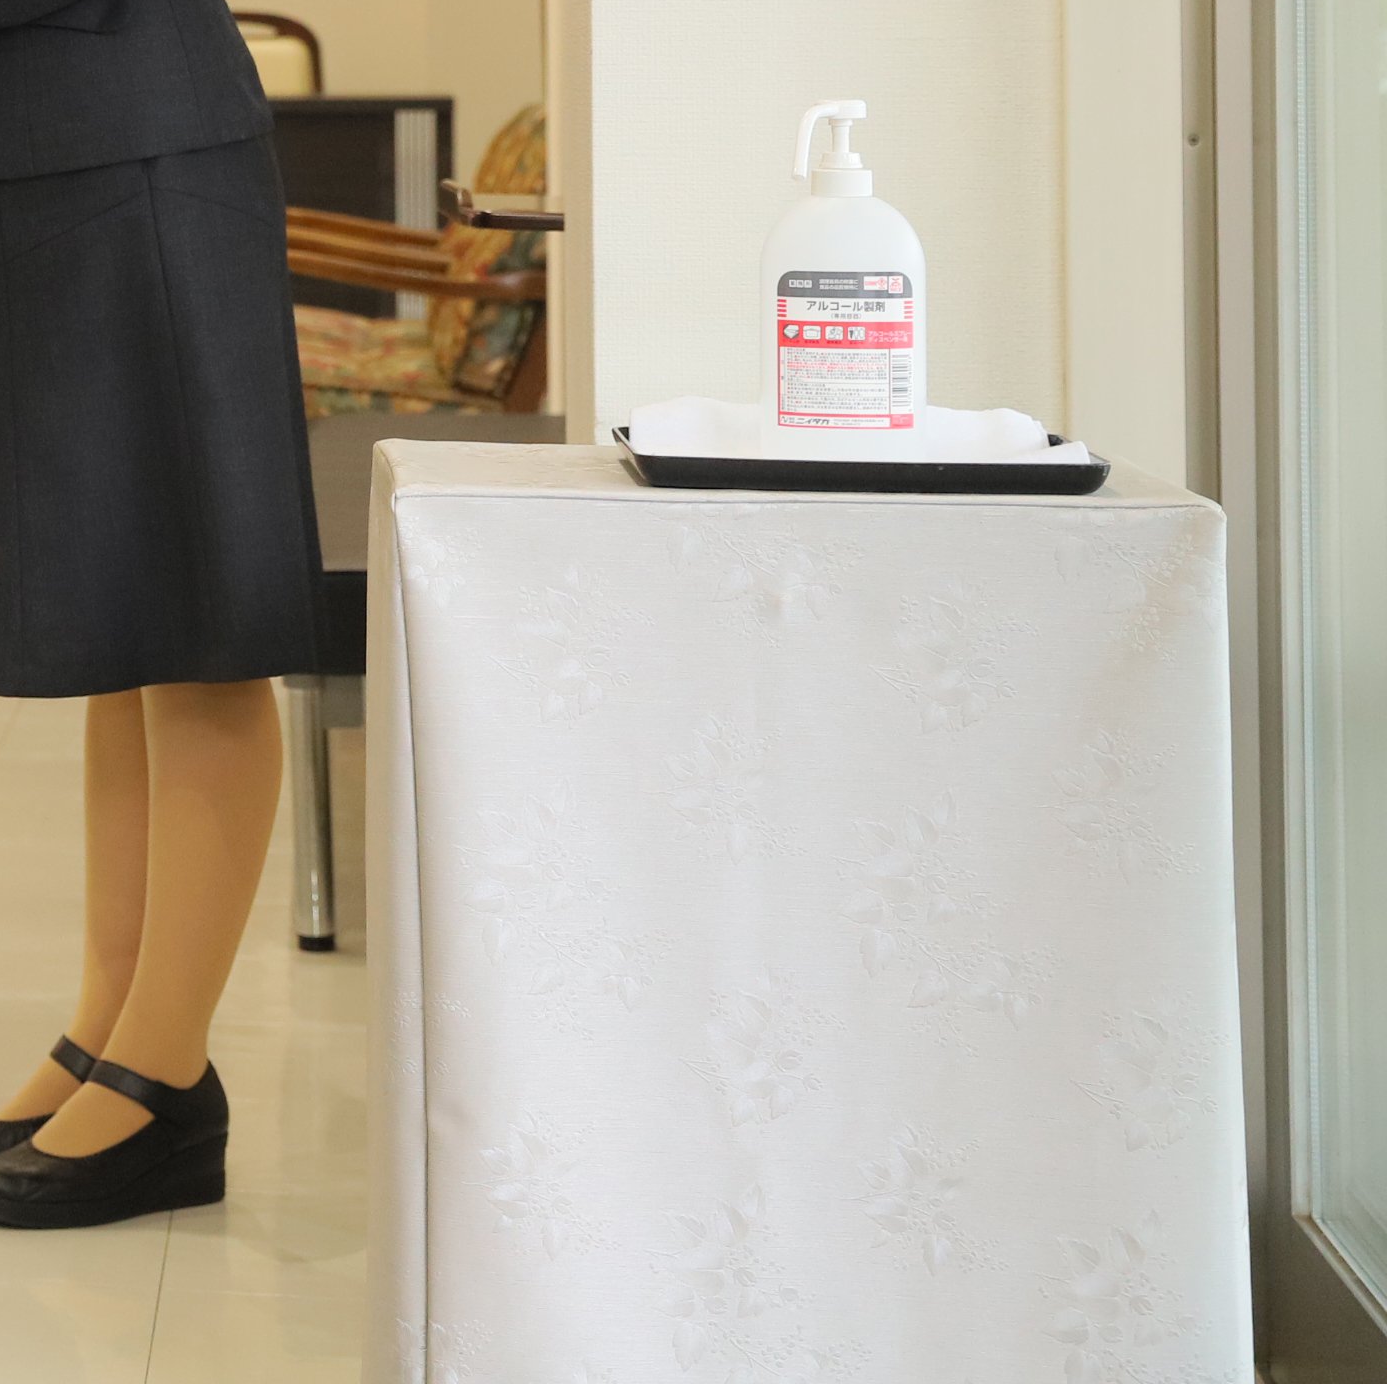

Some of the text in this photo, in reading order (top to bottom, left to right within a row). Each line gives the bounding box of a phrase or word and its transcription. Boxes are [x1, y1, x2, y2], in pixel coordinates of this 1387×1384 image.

[806, 300, 886, 312] アルコール製剤
